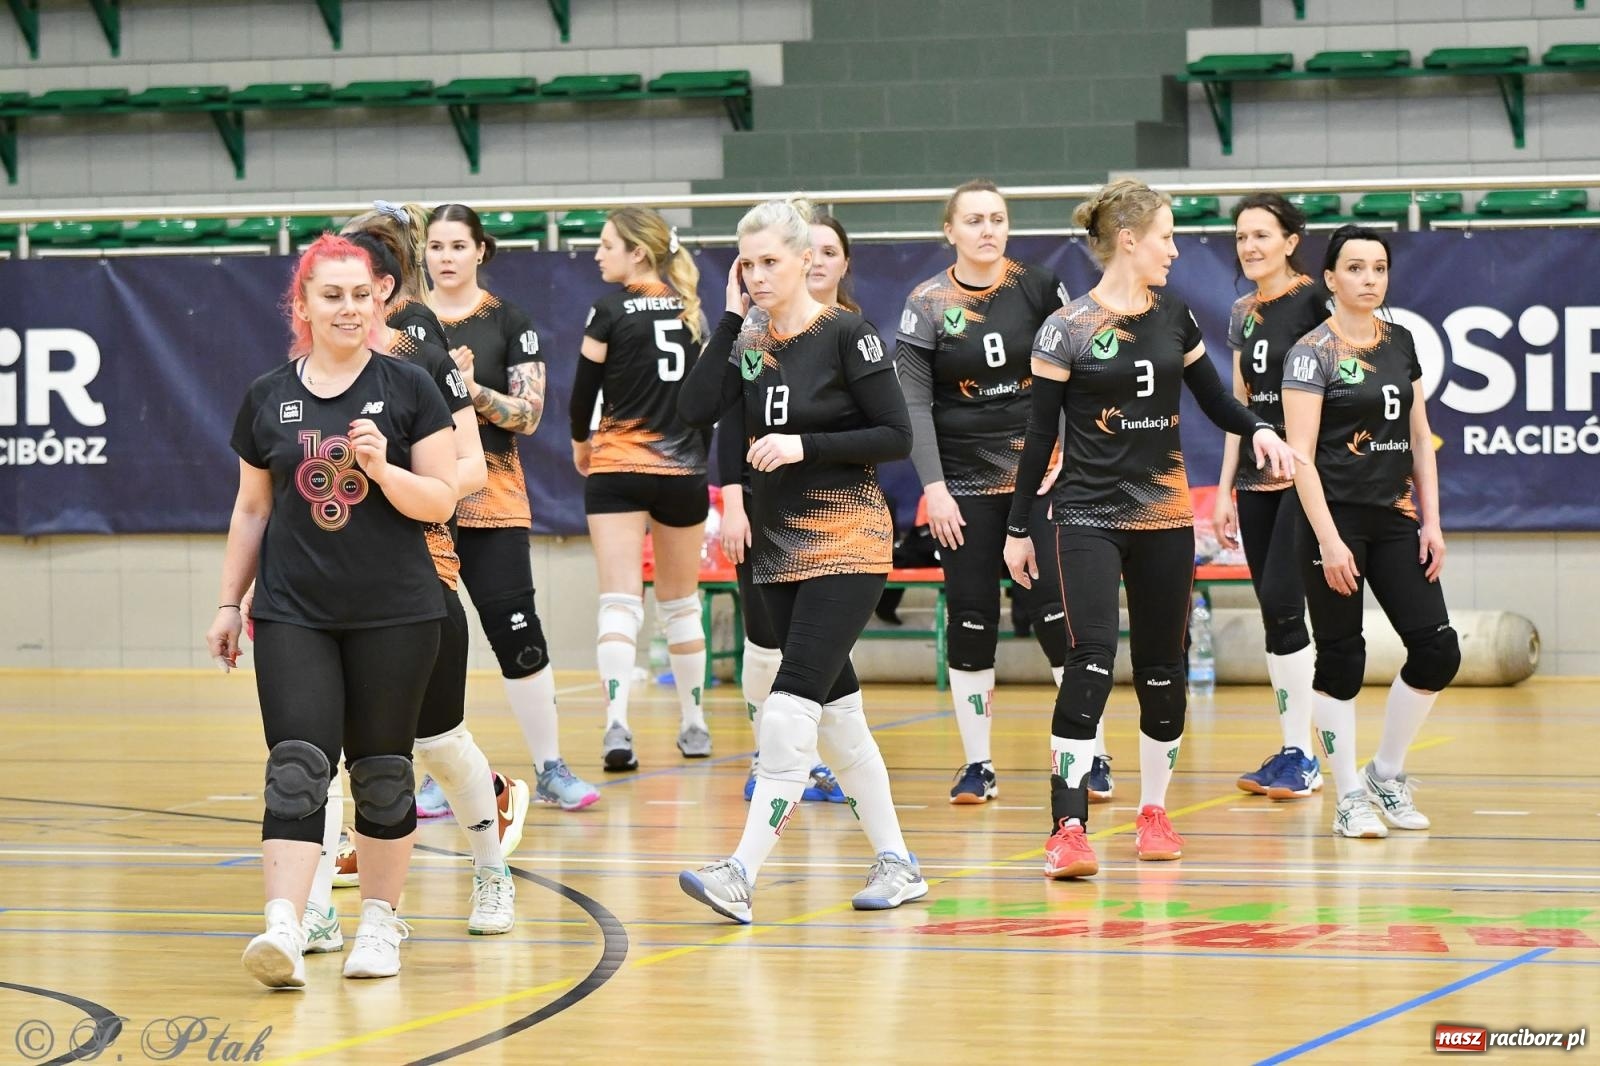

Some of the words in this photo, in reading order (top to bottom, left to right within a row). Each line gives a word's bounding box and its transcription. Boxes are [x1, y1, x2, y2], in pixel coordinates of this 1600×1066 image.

[653, 319, 686, 382] 5
[983, 332, 1007, 368] 8
[1252, 339, 1269, 374] 9
[1134, 359, 1155, 397] 3
[764, 384, 790, 427] 13
[1381, 384, 1401, 421] 6
[1121, 415, 1169, 431] Fundacja
